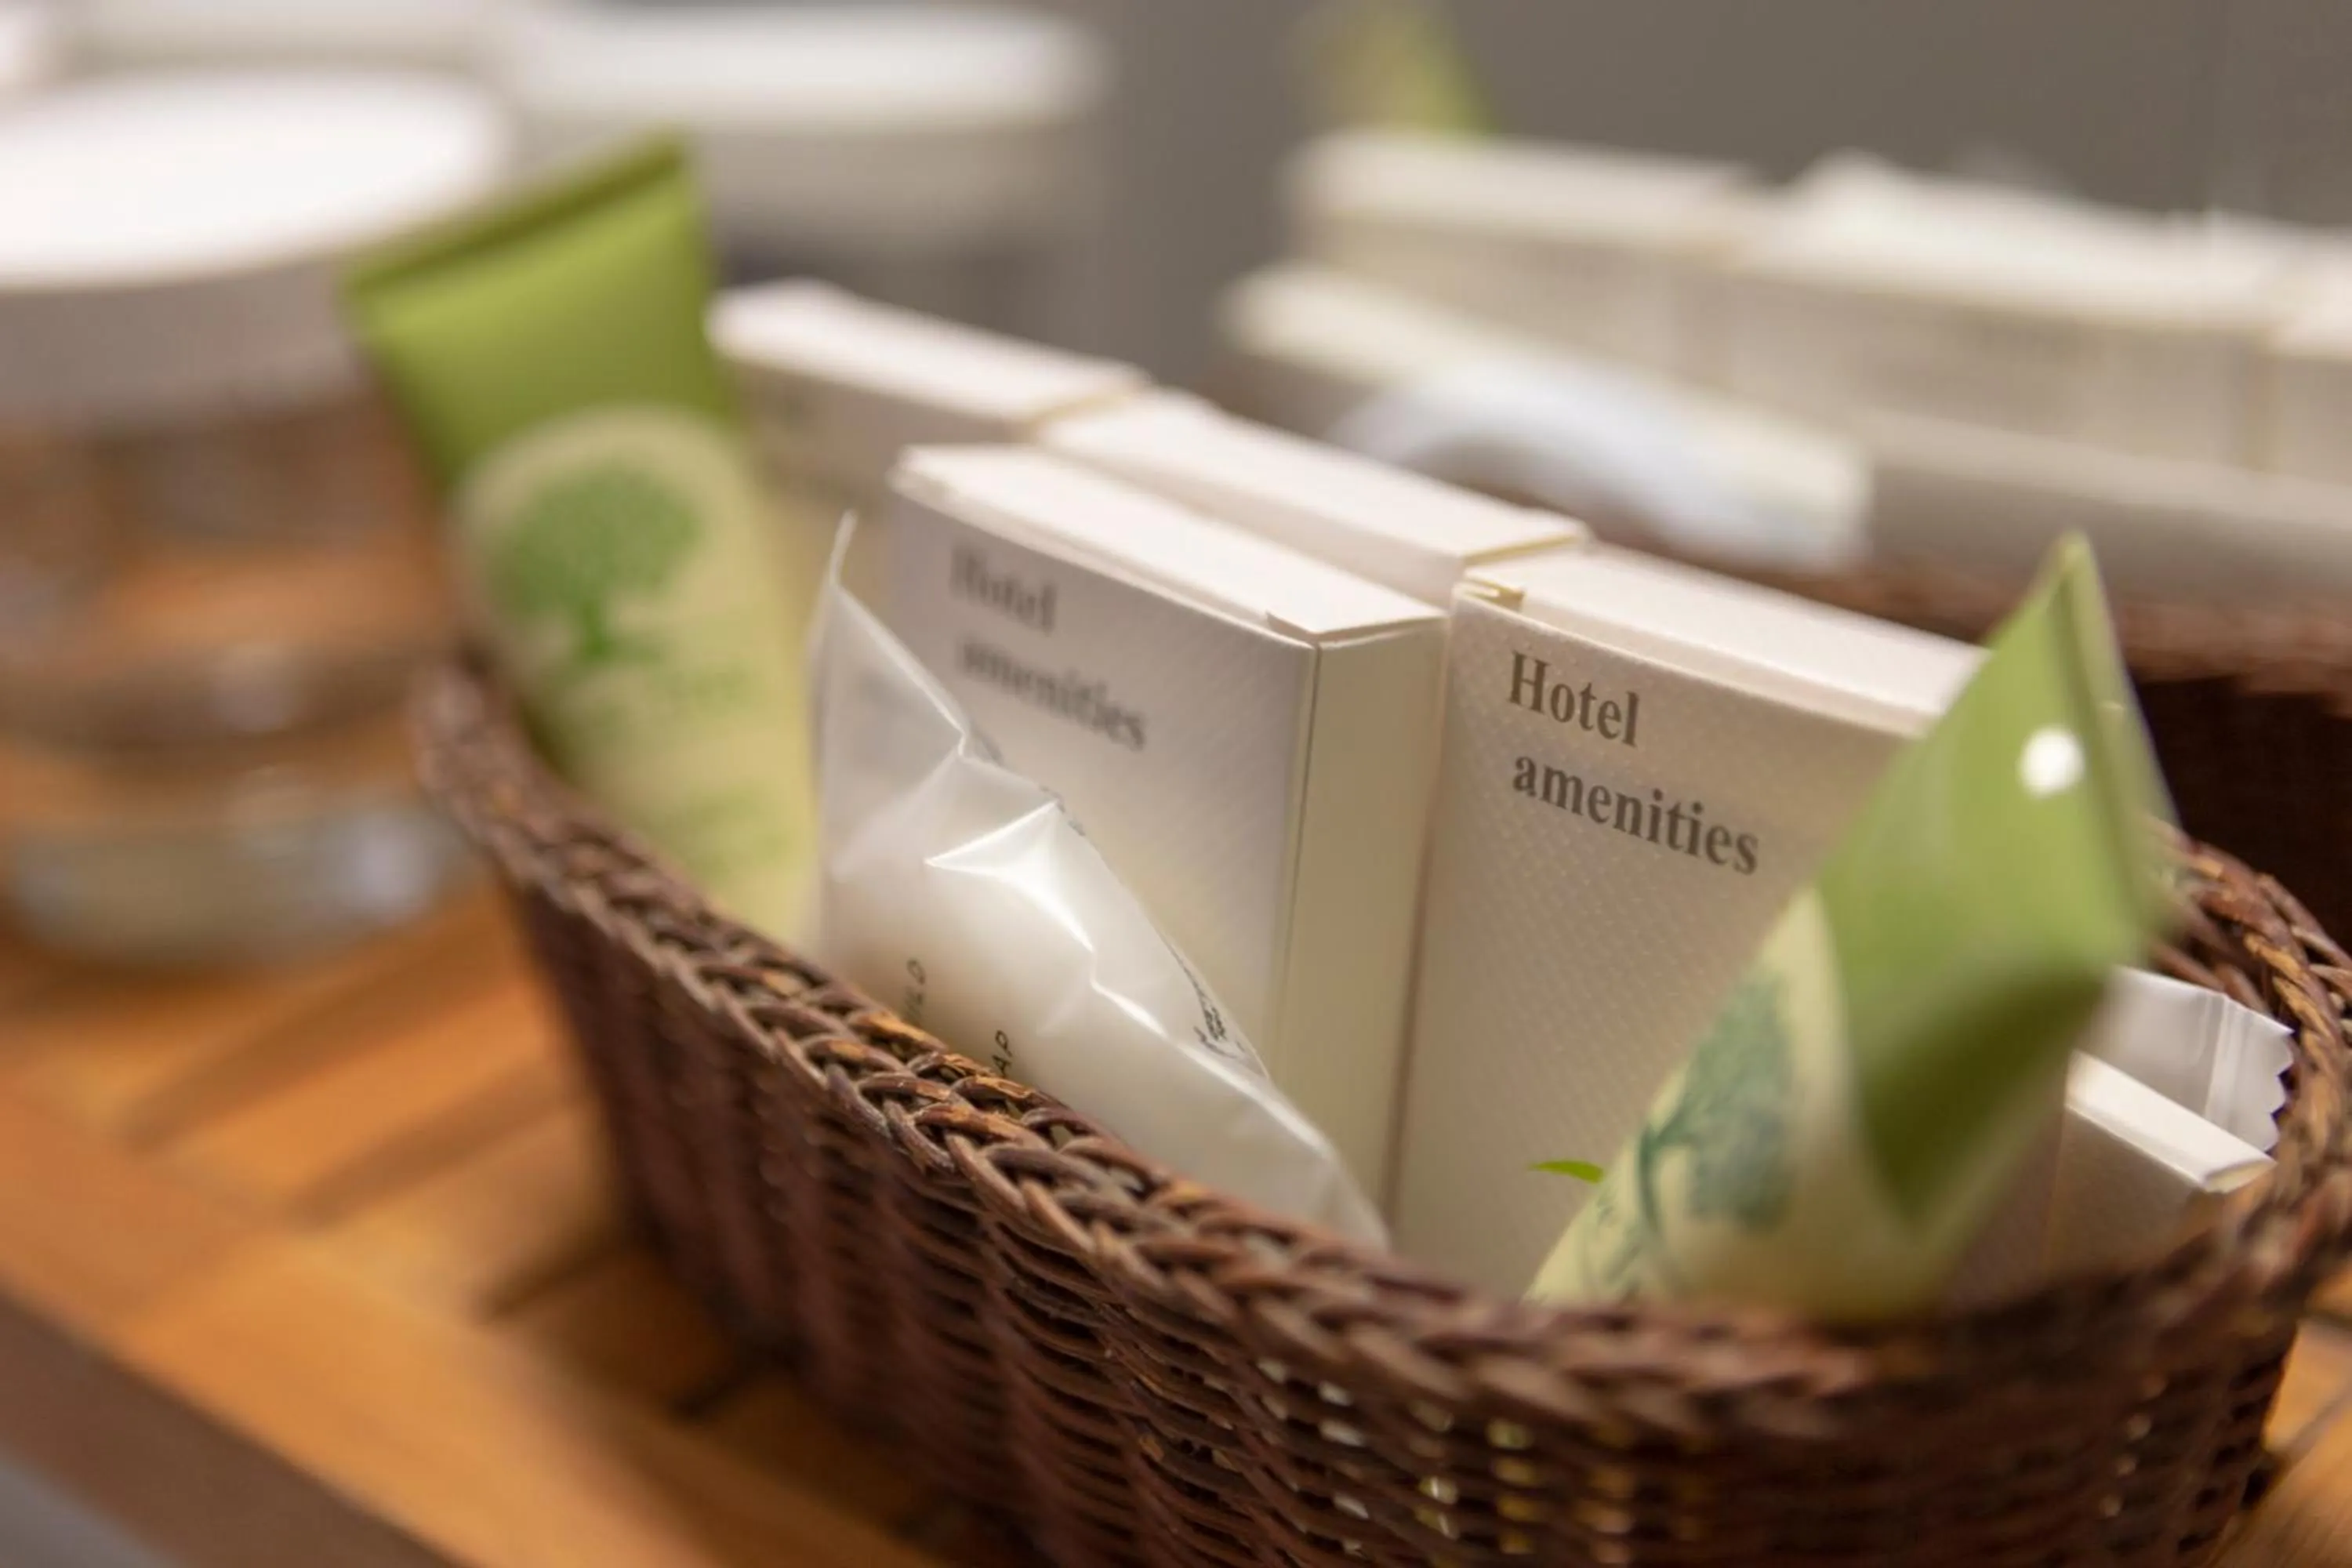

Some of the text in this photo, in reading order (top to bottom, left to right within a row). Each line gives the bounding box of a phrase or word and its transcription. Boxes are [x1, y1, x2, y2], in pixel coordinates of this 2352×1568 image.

[951, 541, 1054, 633] Hotel
[1507, 650, 1639, 747] Hotel
[1512, 756, 1759, 875] amenities
[991, 1029, 1012, 1077] AP
